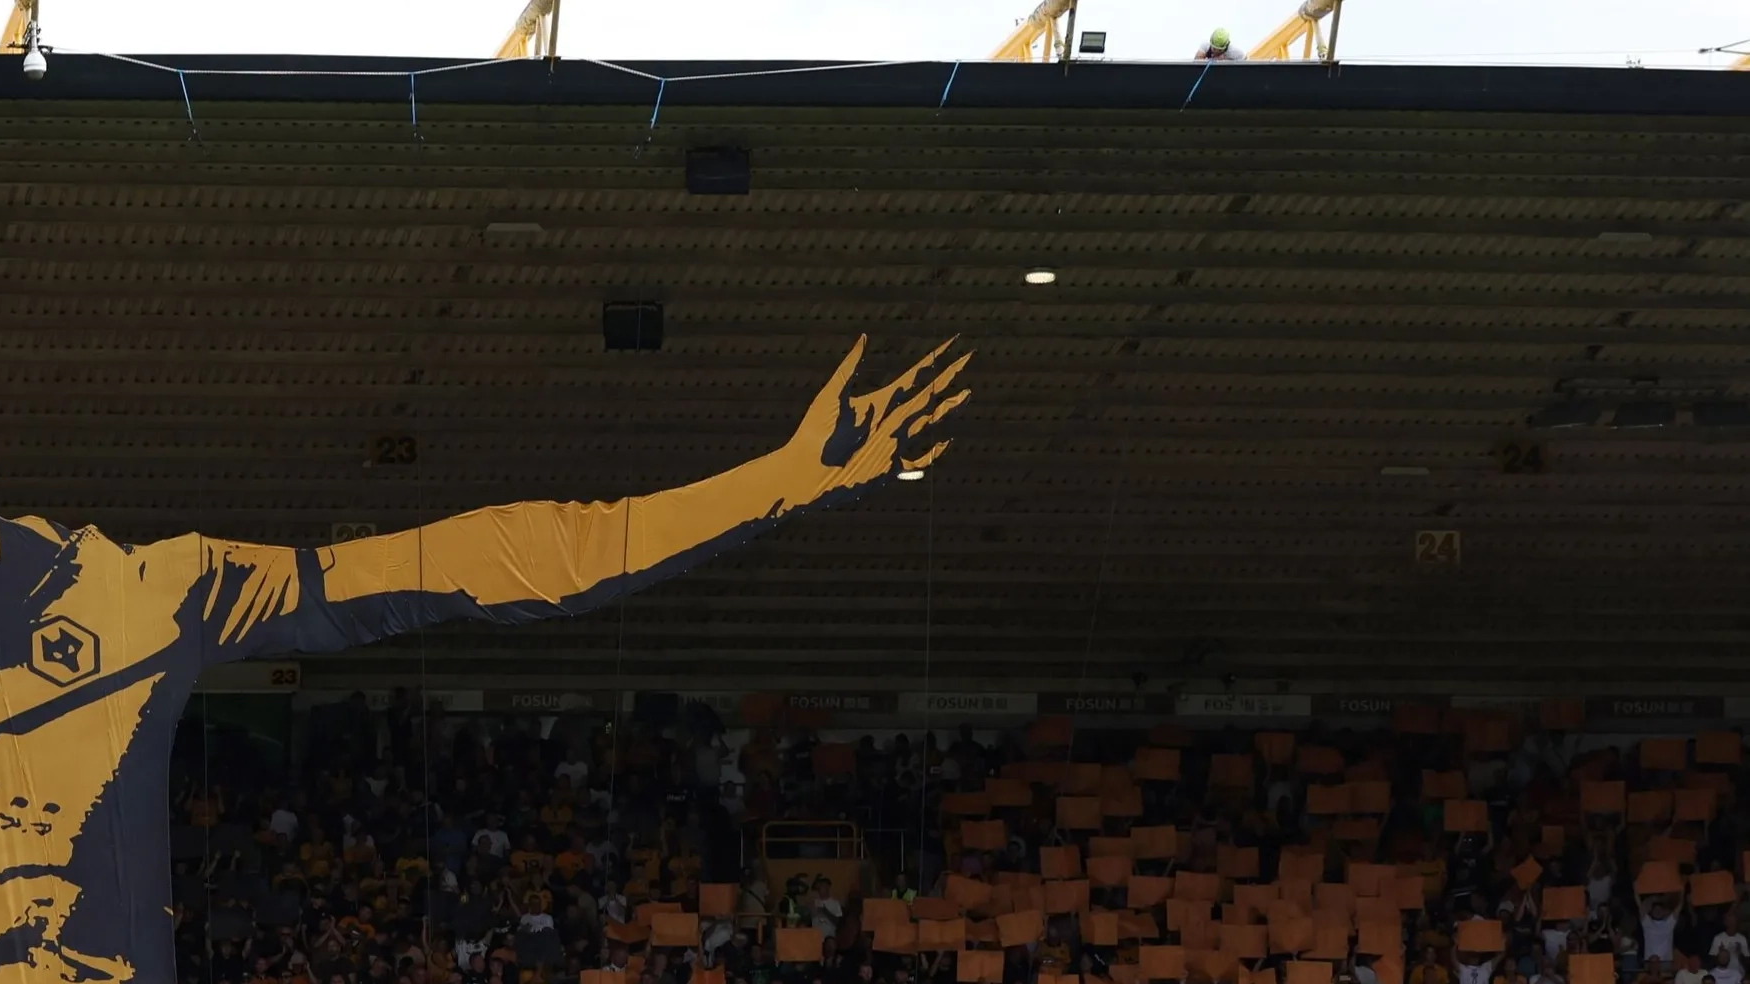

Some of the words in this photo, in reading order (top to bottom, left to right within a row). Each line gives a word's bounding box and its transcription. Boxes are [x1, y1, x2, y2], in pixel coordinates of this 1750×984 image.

[376, 436, 417, 464] 23
[1502, 443, 1544, 474] 24
[1418, 532, 1458, 562] 24
[272, 669, 297, 685] 23
[789, 697, 841, 709] FOSUN
[927, 698, 979, 710] FOSUN
[1064, 699, 1117, 711] FOSUN
[1339, 700, 1391, 712] FOSUN
[1613, 702, 1666, 714] FOSUN
